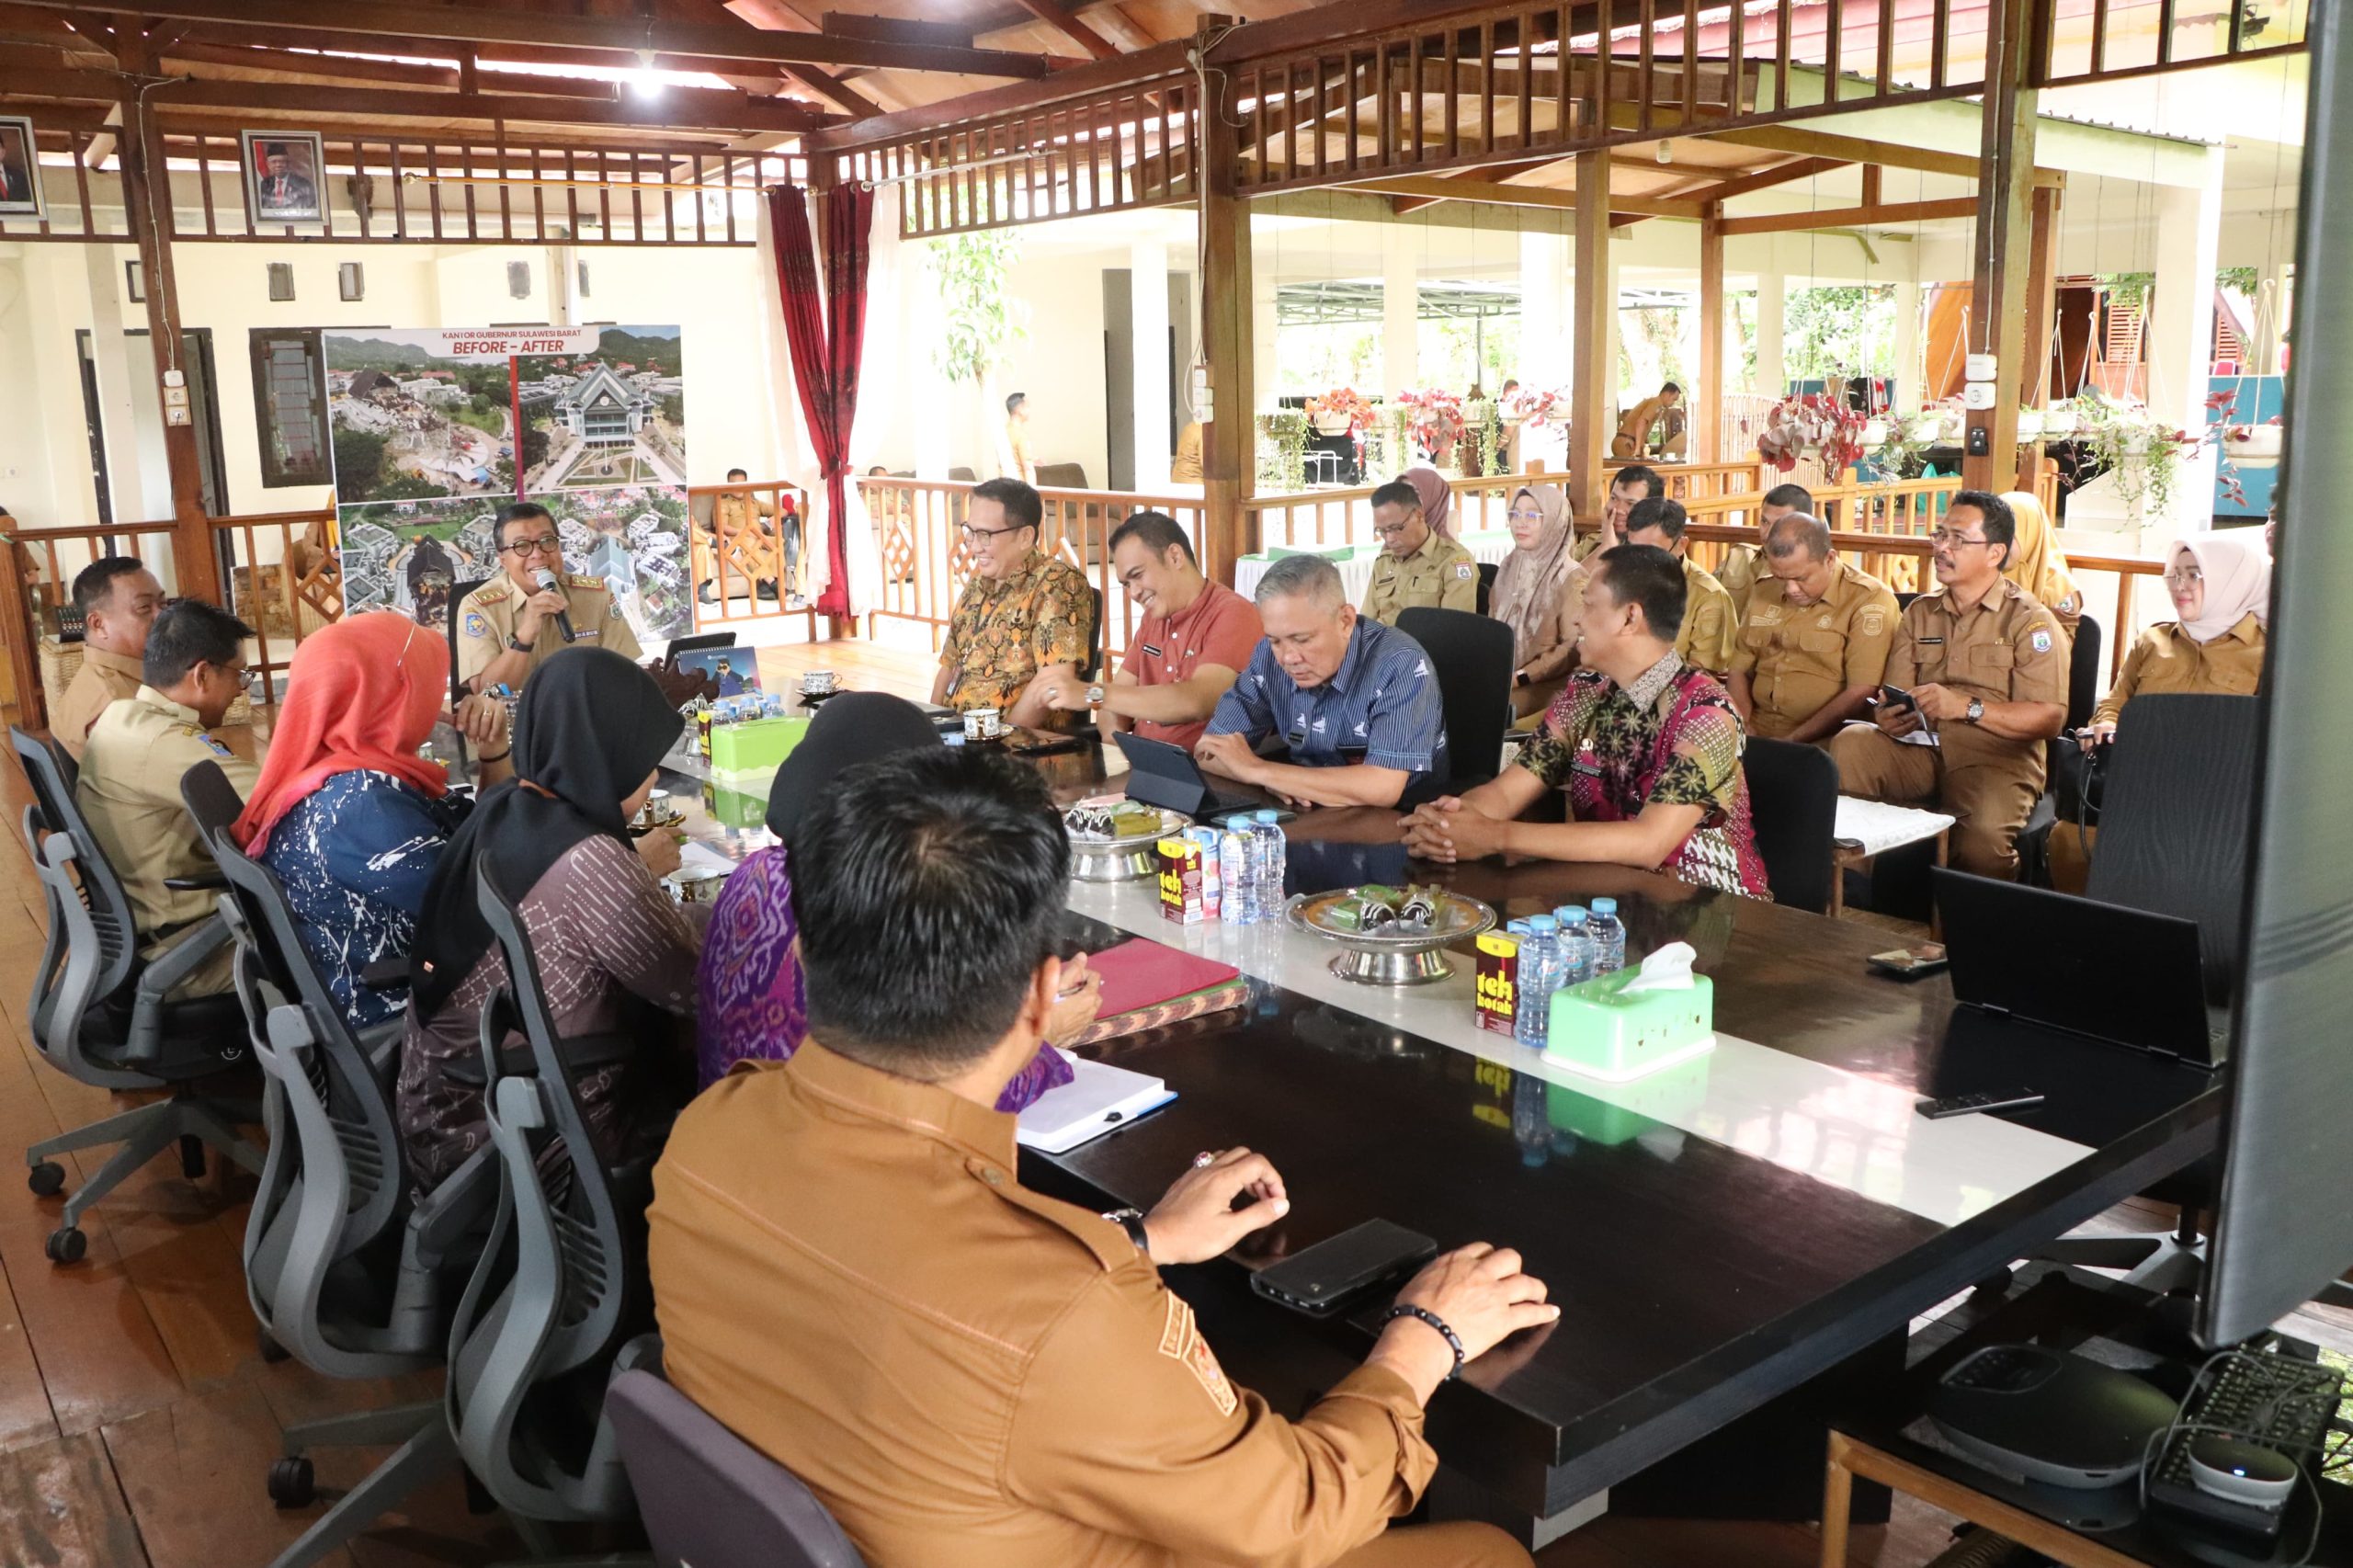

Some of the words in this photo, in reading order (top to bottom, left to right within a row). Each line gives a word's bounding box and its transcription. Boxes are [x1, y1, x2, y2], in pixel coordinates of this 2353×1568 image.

[442, 331, 475, 339] KANTOR
[518, 330, 556, 338] SULAWESI
[557, 329, 581, 337] BARAT
[453, 341, 507, 354] BEFORE
[520, 340, 564, 353] AFTER
[1159, 869, 1182, 894] teh
[1476, 970, 1513, 1001] teh
[1476, 992, 1512, 1016] kotak
